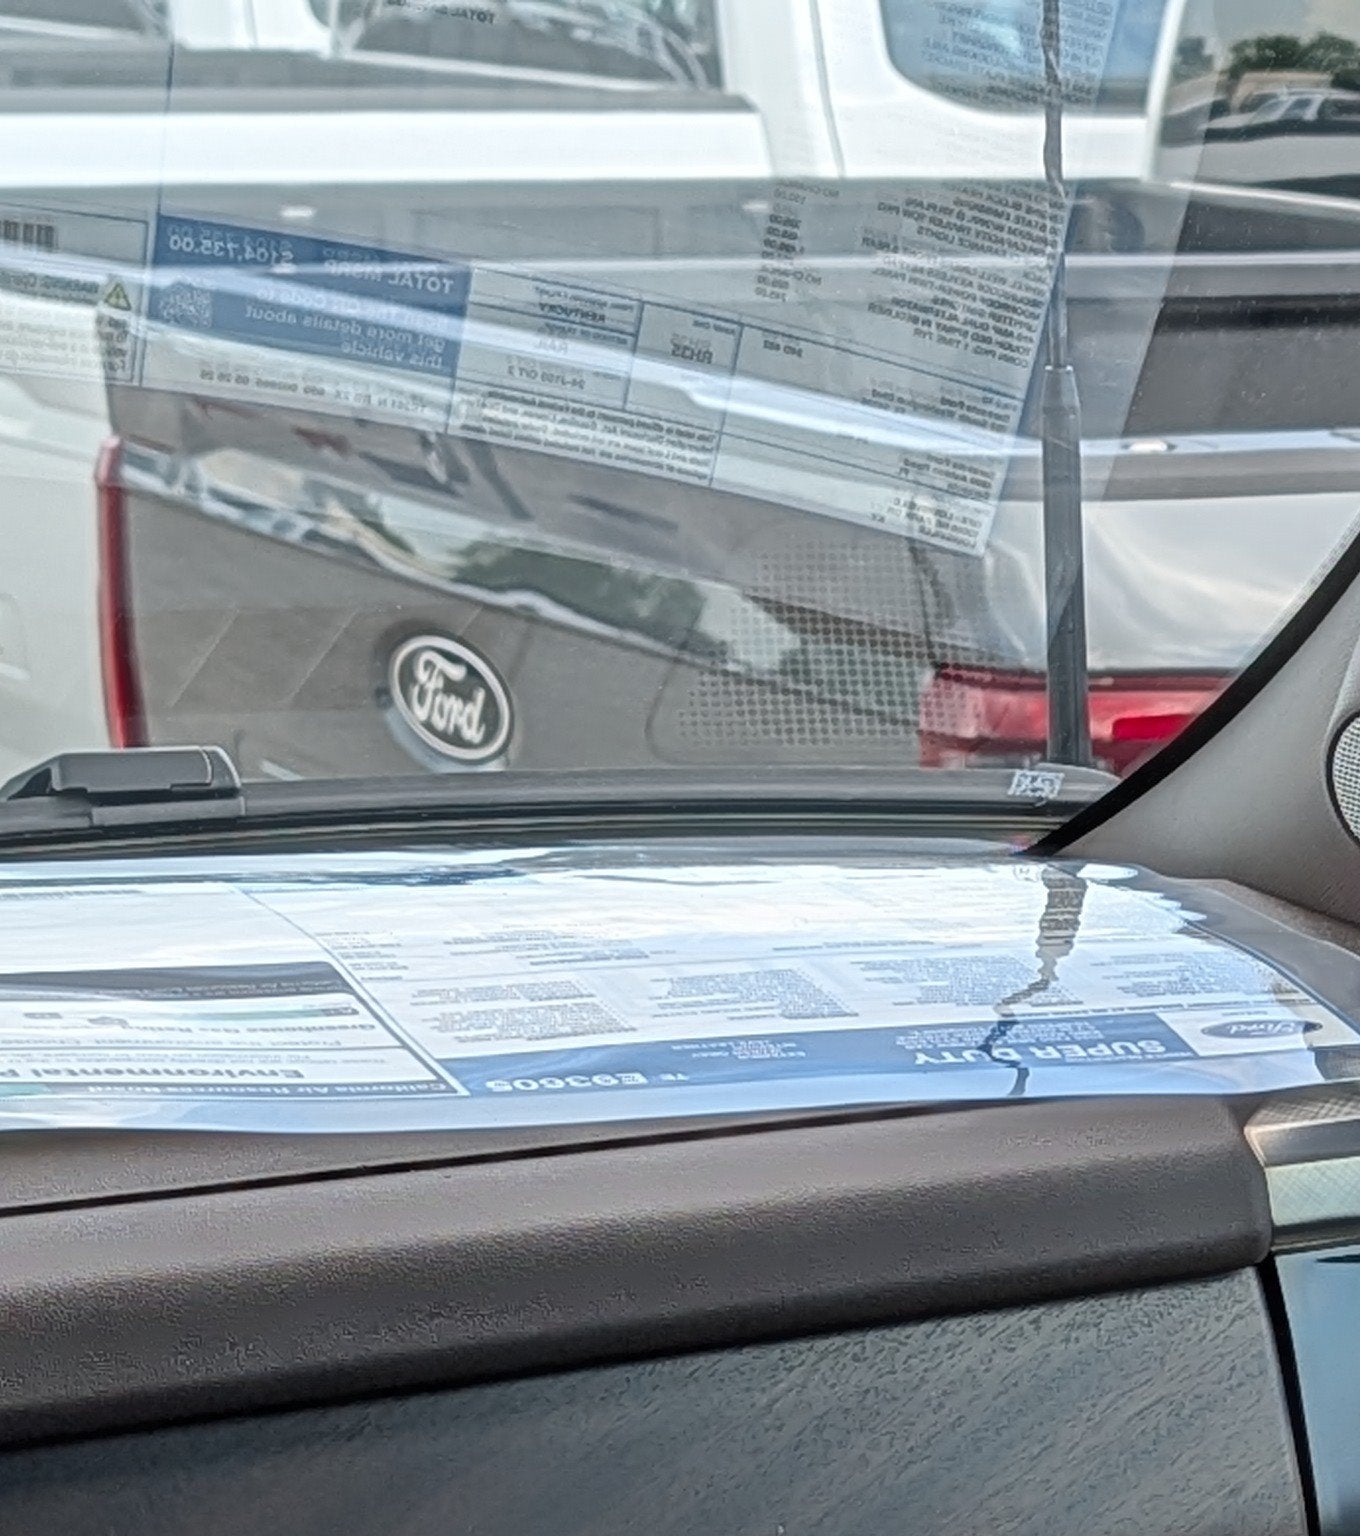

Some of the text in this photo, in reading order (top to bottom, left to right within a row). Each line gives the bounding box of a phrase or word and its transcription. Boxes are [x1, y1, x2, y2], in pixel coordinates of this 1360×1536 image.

[411, 650, 486, 744] Ford
[1228, 1021, 1297, 1035] Ford
[915, 1040, 1166, 1065] SUPER DUTY
[31, 1068, 305, 1080] Environmental
